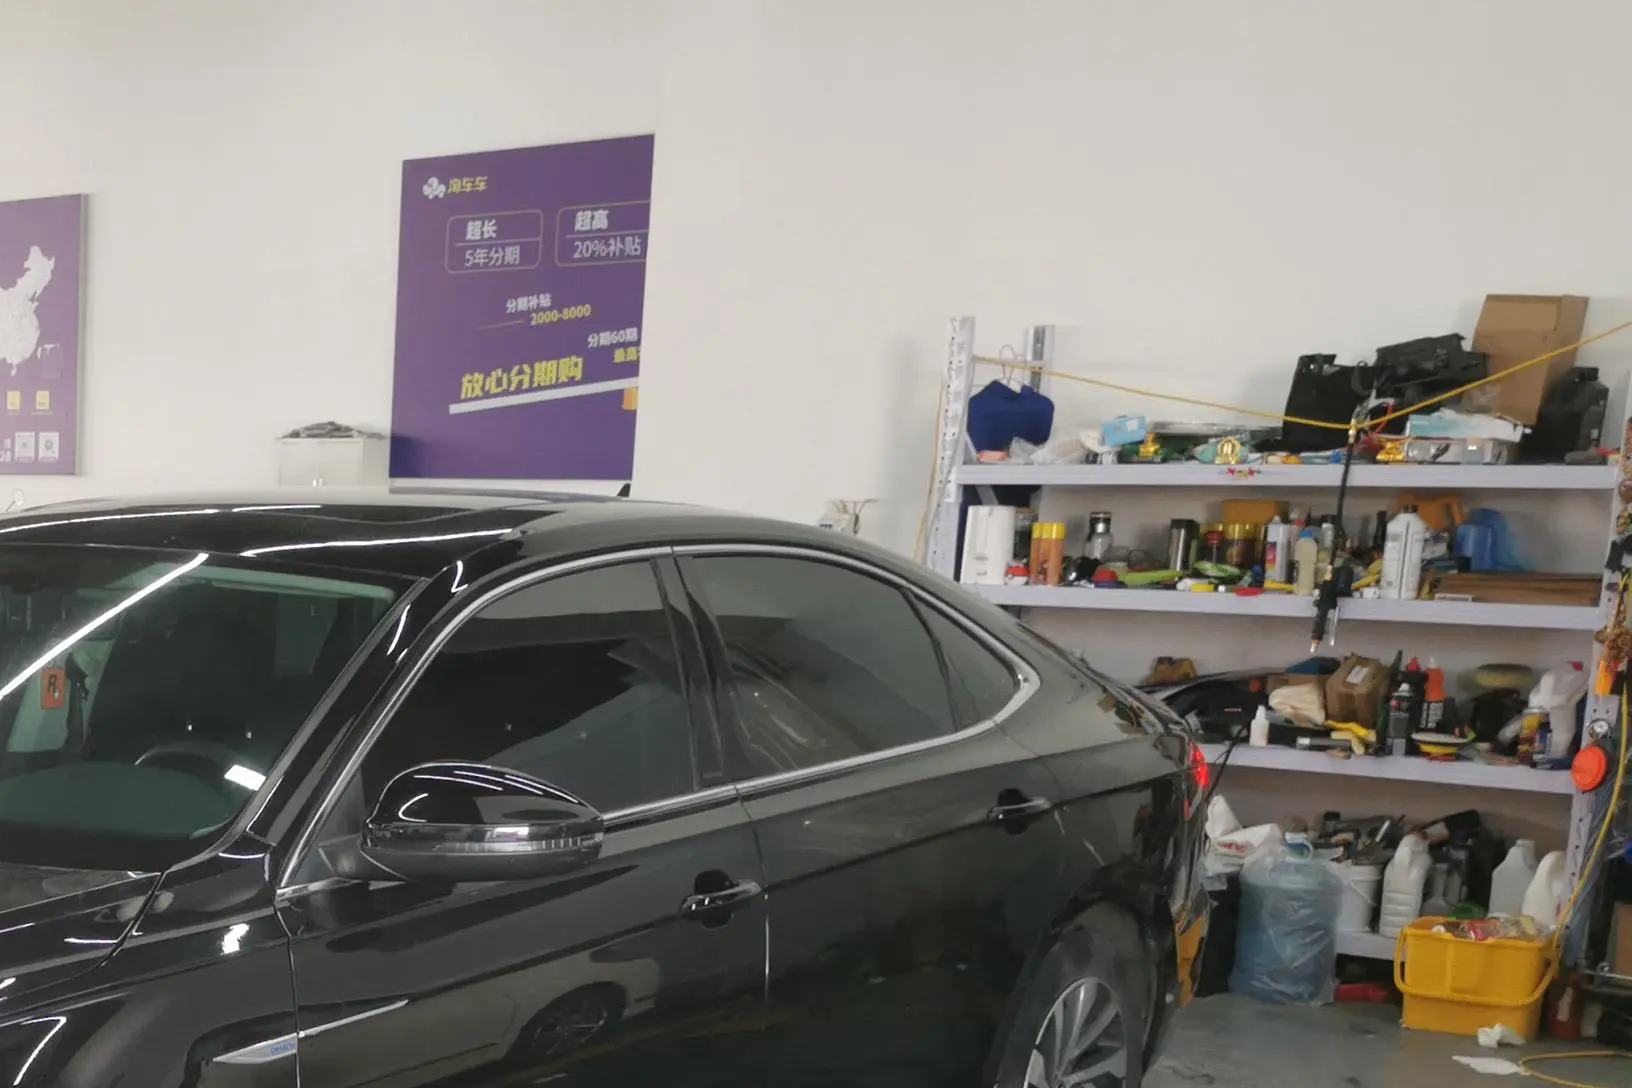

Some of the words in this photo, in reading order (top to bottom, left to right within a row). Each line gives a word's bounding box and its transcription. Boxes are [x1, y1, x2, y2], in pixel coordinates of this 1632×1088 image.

[447, 176, 488, 194] 淘车车
[465, 219, 498, 241] 超长
[574, 210, 609, 232] 超高
[464, 246, 521, 268] 5年分期
[573, 235, 641, 259] 20%补贴
[461, 356, 583, 399] 放心分期购
